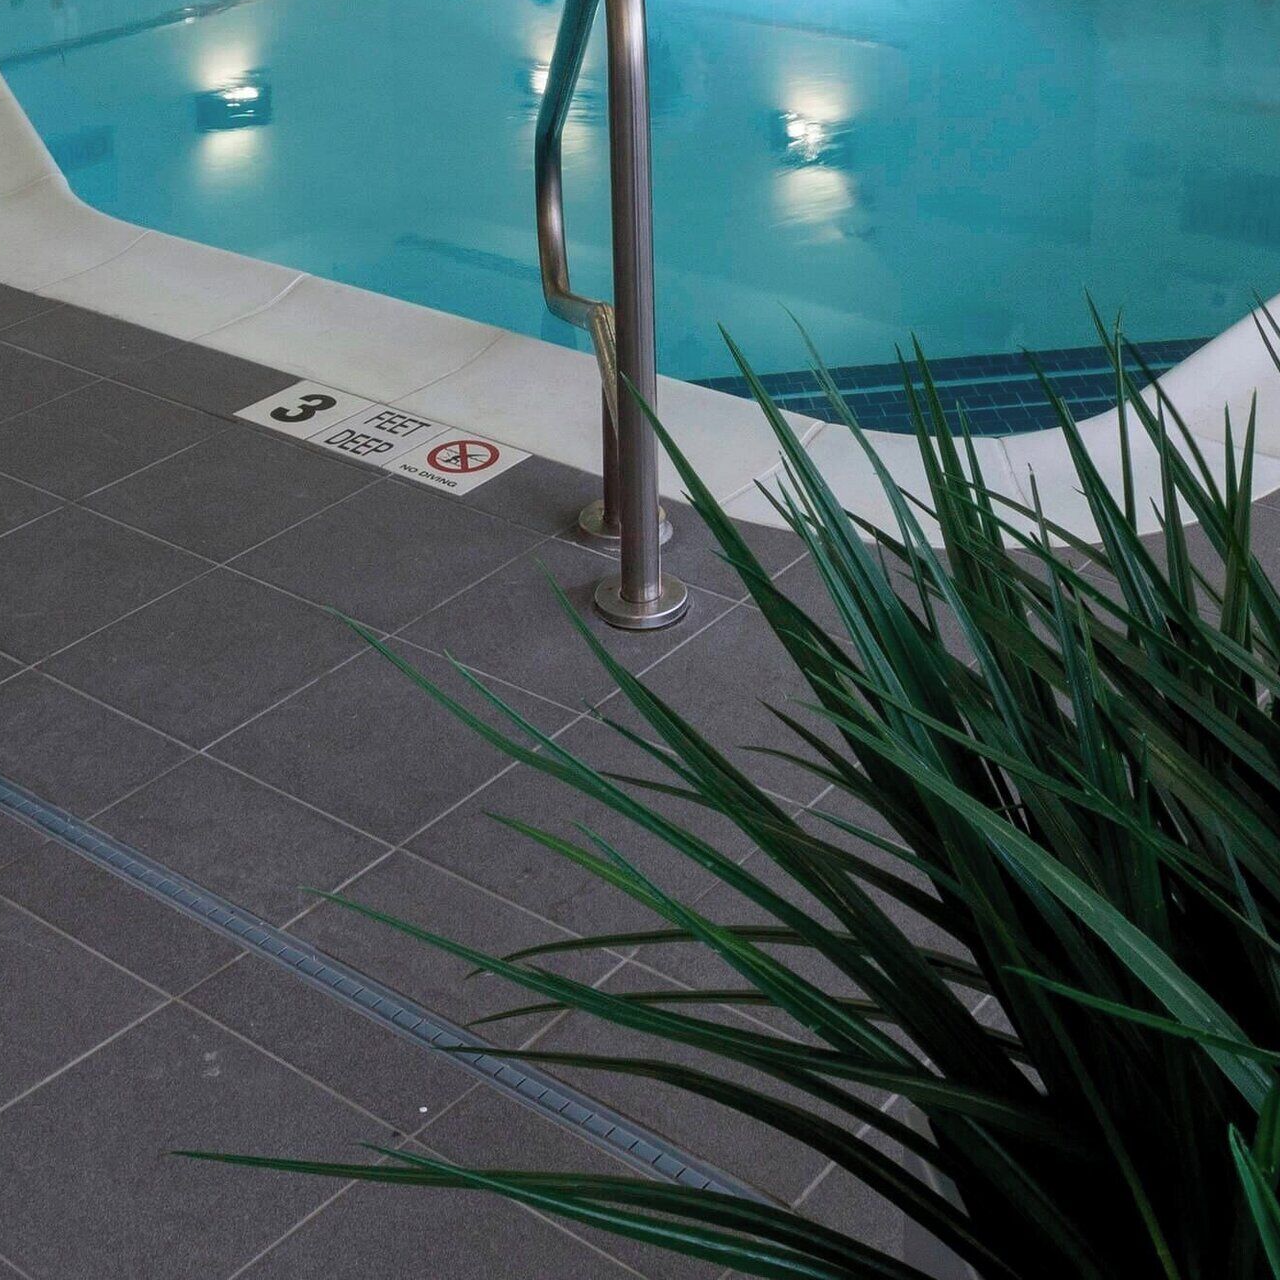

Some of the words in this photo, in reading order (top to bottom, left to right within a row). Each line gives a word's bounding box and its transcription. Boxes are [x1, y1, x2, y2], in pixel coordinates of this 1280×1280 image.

[270, 393, 337, 423] 3
[364, 411, 432, 437] FEET
[324, 429, 394, 457] DEEP
[399, 463, 418, 473] NO
[418, 469, 458, 488] DIVING
